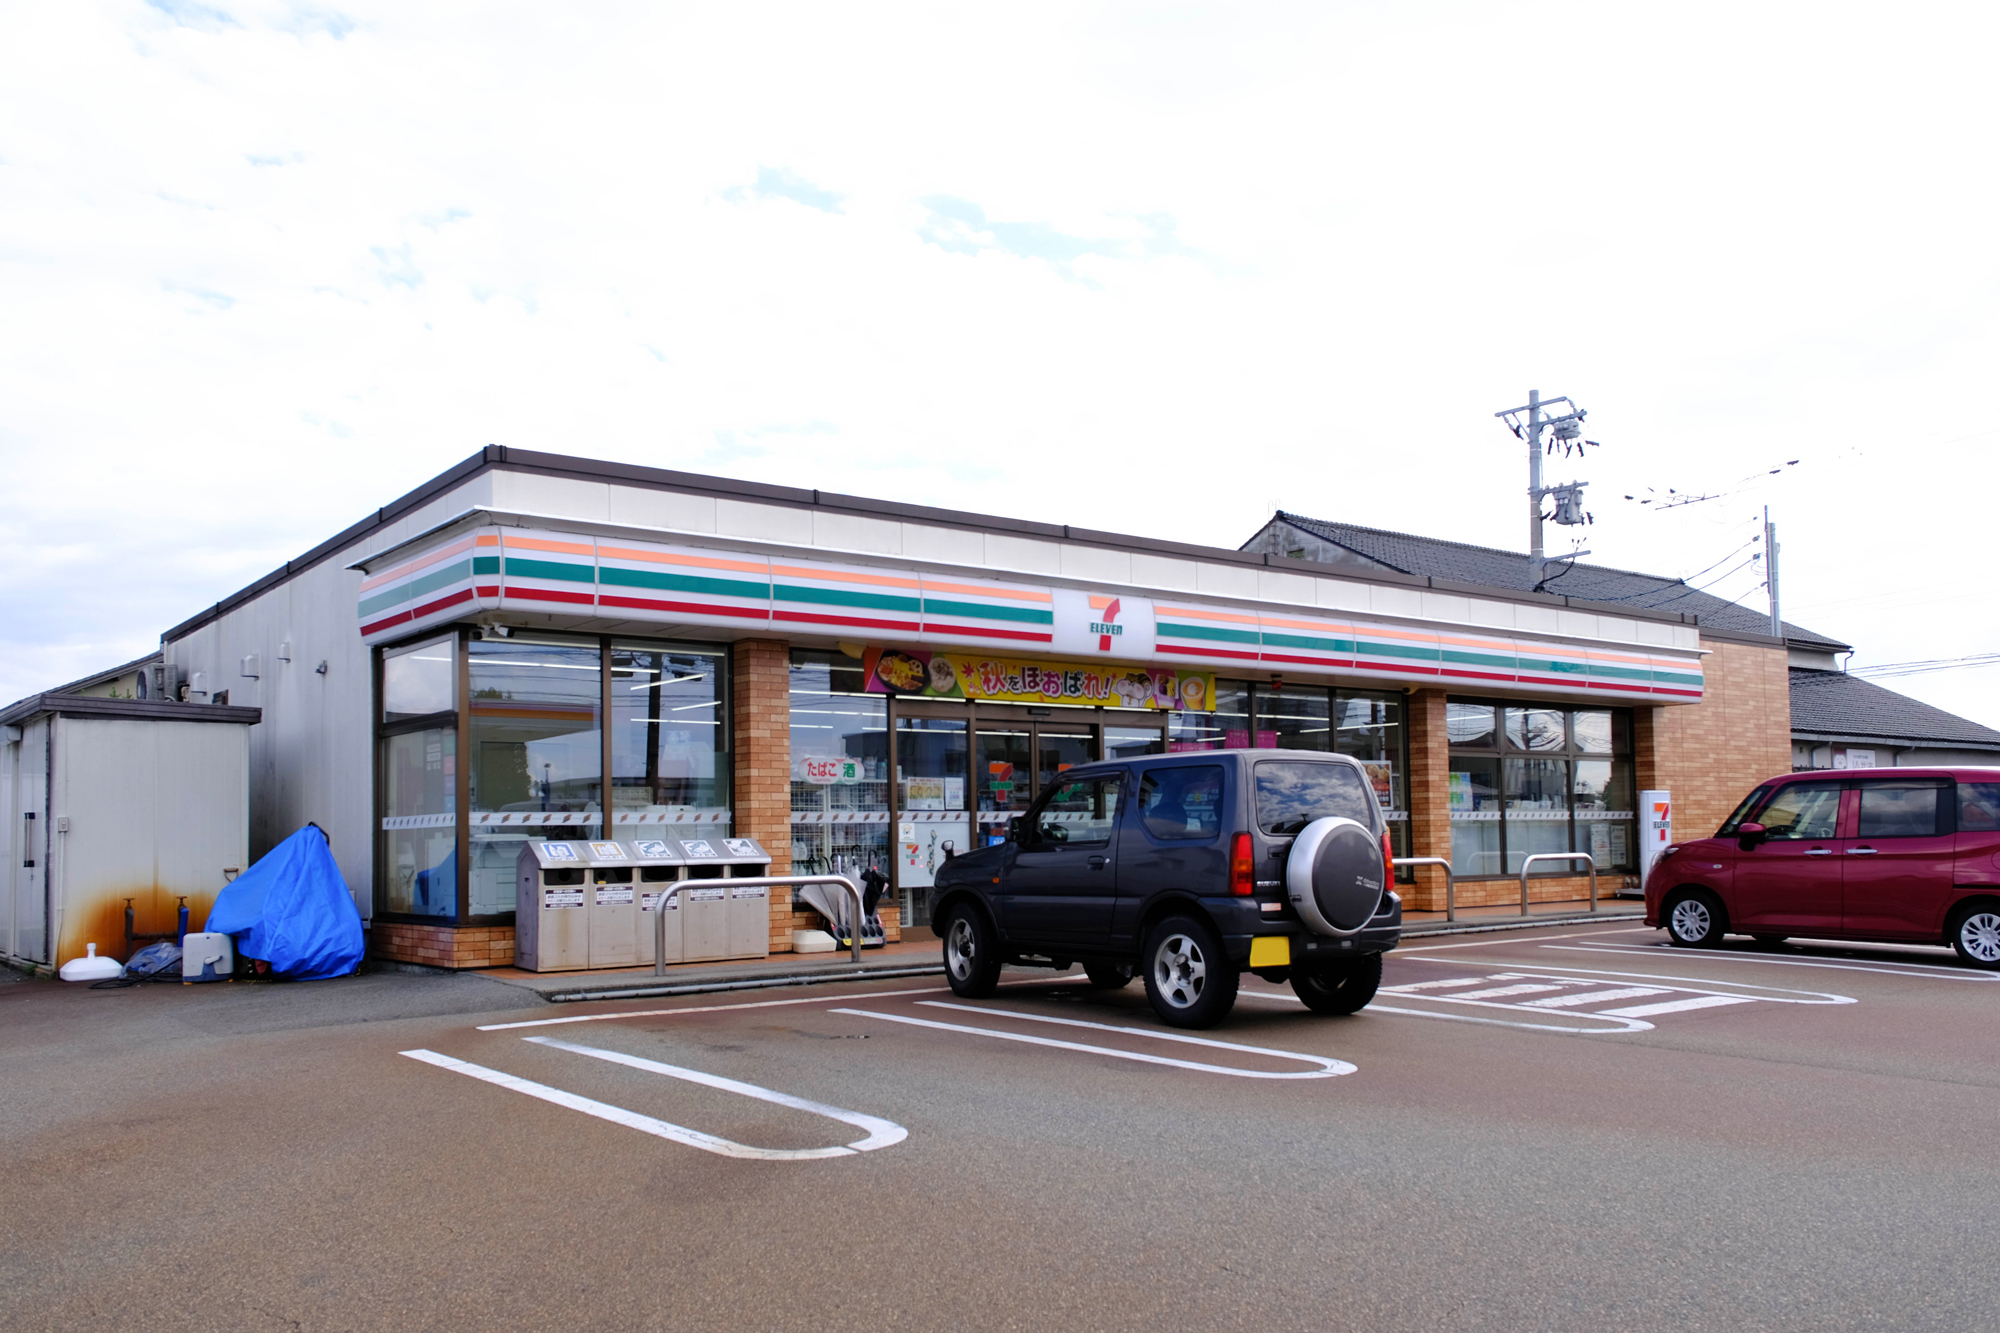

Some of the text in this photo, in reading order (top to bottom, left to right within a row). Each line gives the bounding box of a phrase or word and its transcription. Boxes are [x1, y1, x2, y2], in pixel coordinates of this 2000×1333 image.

[1089, 596, 1121, 651] 7
[978, 660, 1112, 699] 秋をほおばれ!
[807, 761, 837, 777] たばこ
[843, 763, 856, 778] 酒
